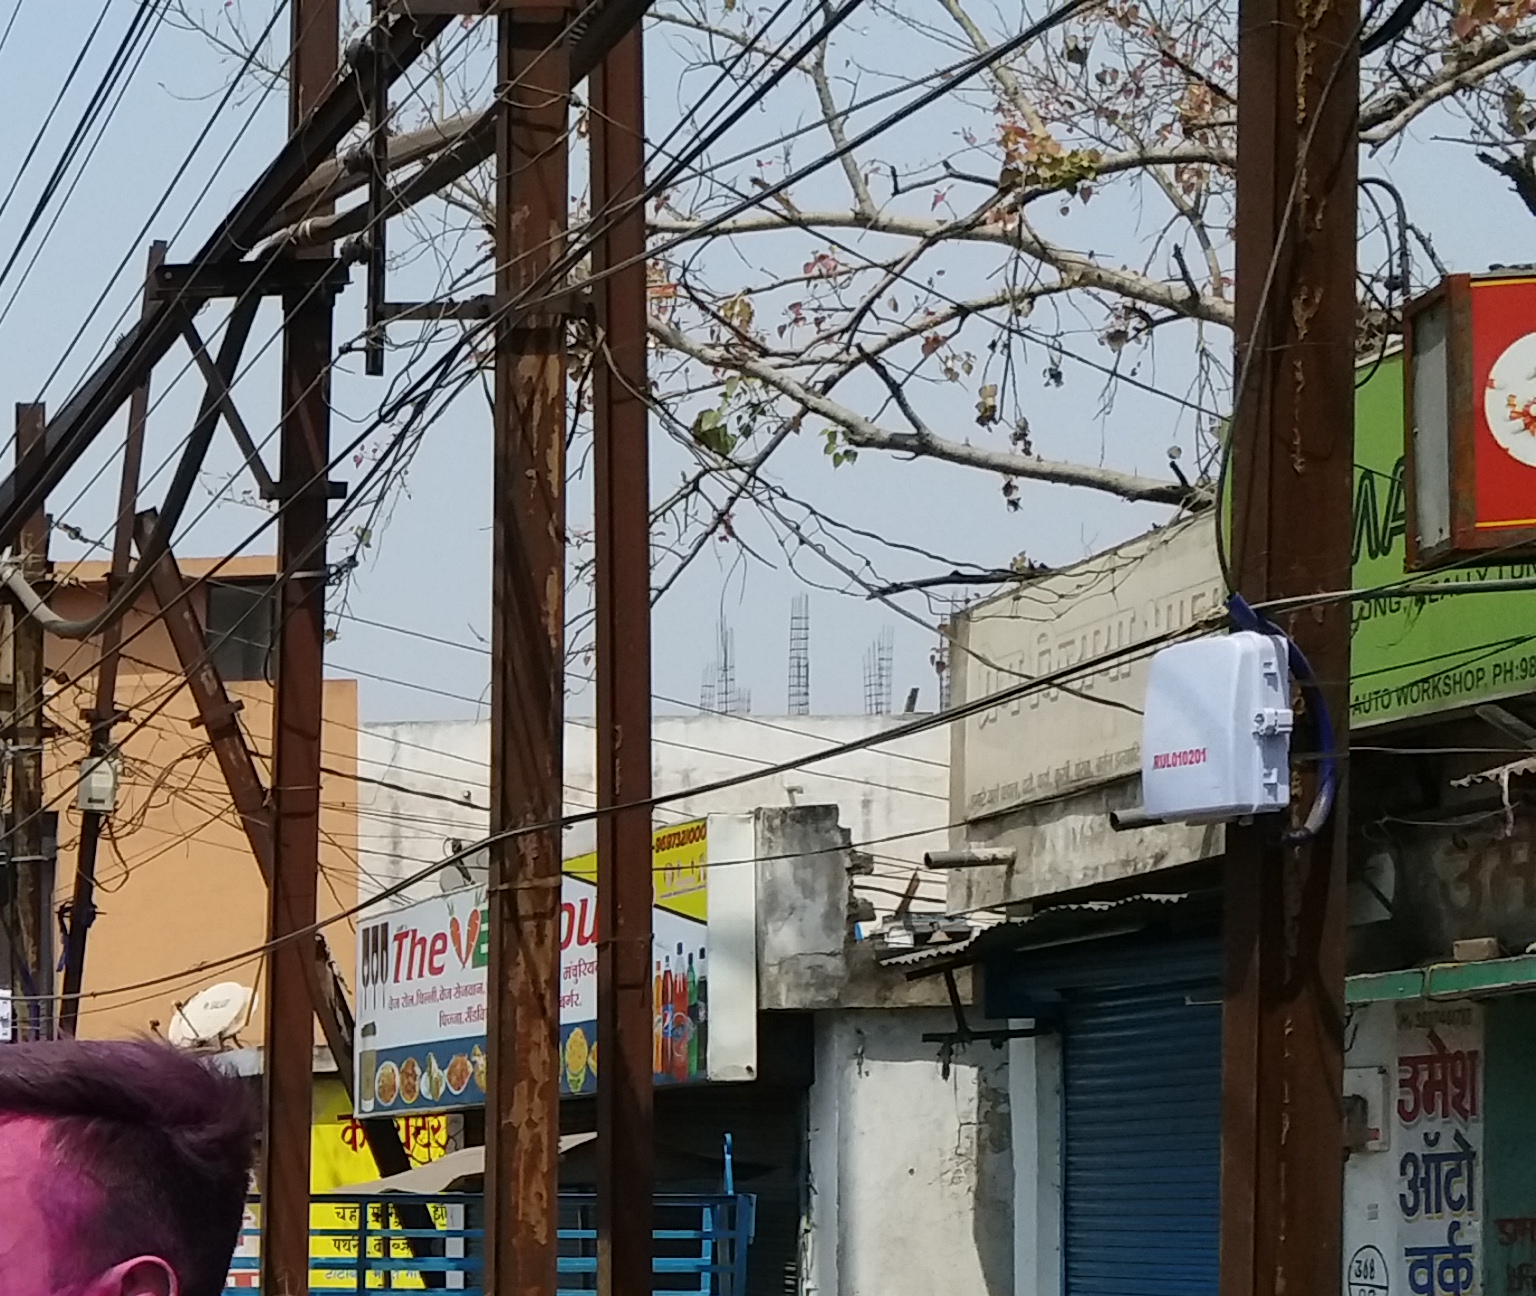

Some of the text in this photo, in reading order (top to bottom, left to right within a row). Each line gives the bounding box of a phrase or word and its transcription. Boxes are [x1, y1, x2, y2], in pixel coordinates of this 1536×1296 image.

[1352, 686, 1392, 717] AUTO
[1394, 666, 1488, 707] WORKSHOP,
[393, 928, 448, 984] The
[1397, 1027, 1480, 1126] उमेश
[1398, 1128, 1477, 1220] ऑटो
